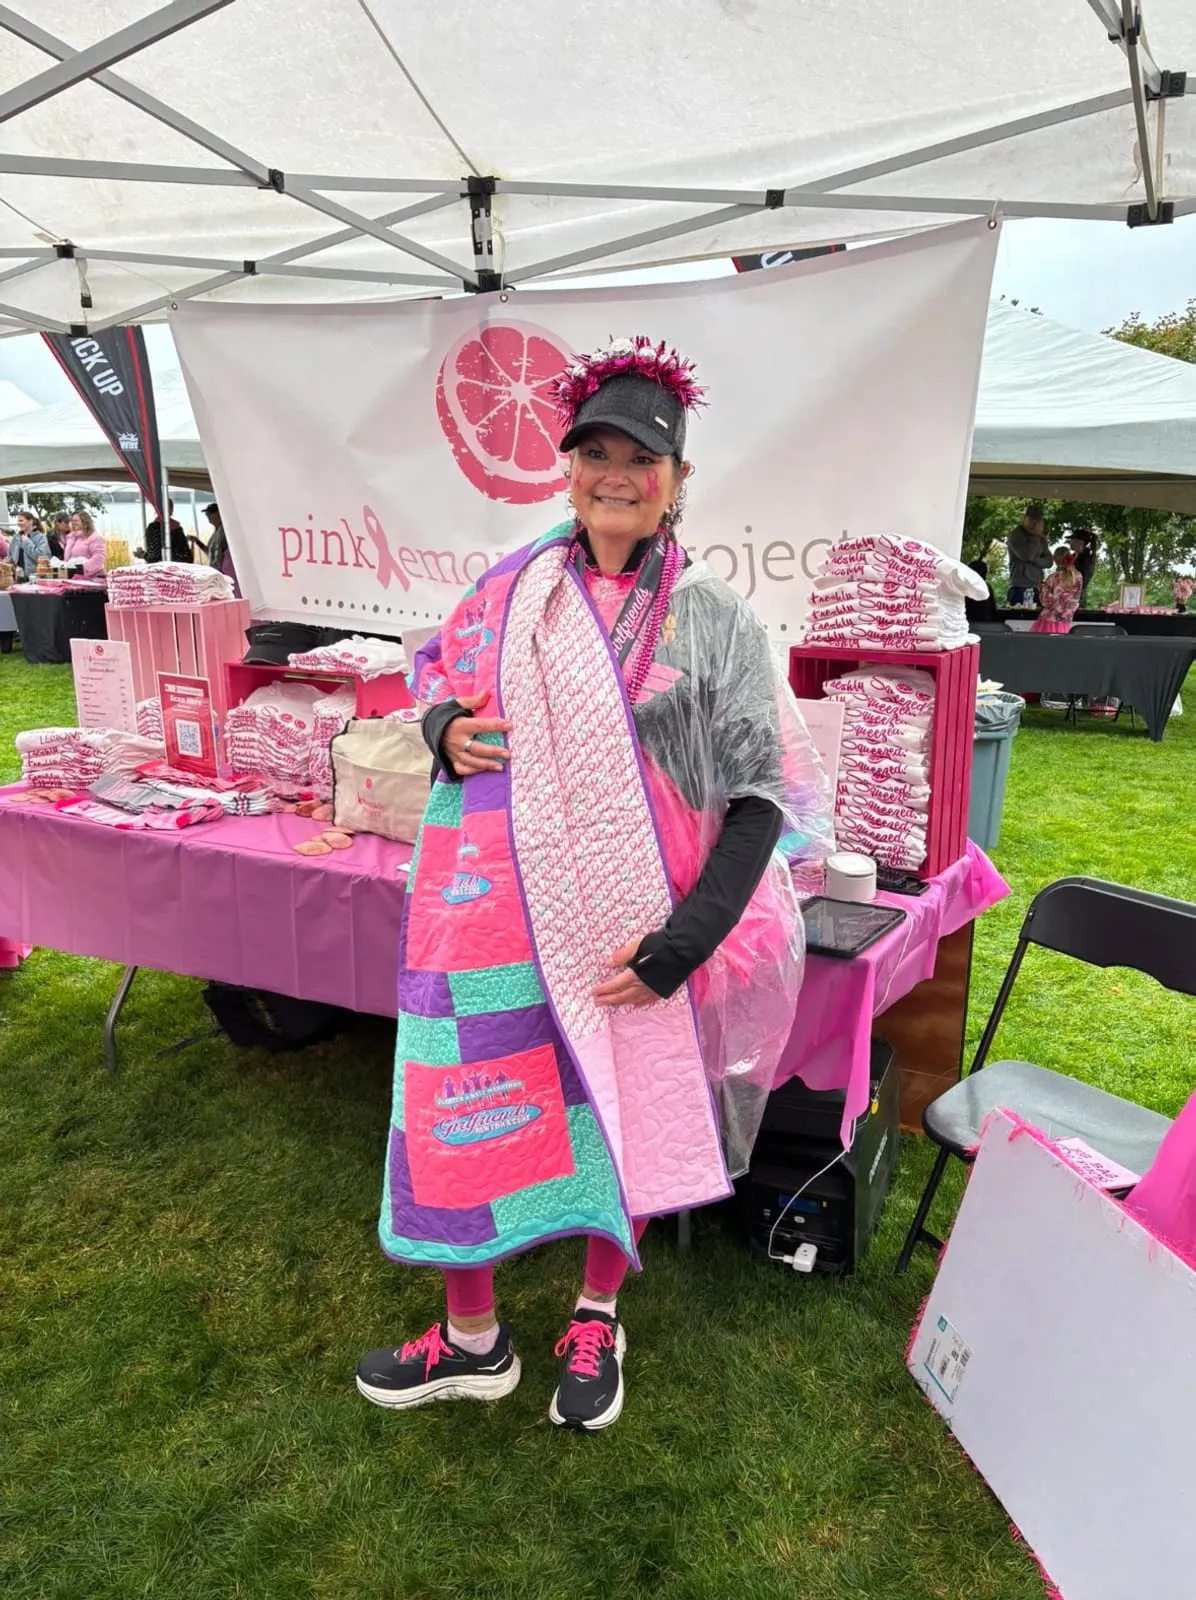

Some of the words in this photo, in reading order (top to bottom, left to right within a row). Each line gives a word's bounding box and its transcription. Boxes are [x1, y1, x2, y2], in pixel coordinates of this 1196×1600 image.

[92, 368, 124, 396] UP
[278, 514, 376, 578] pink
[438, 1102, 529, 1139] Girlfriends
